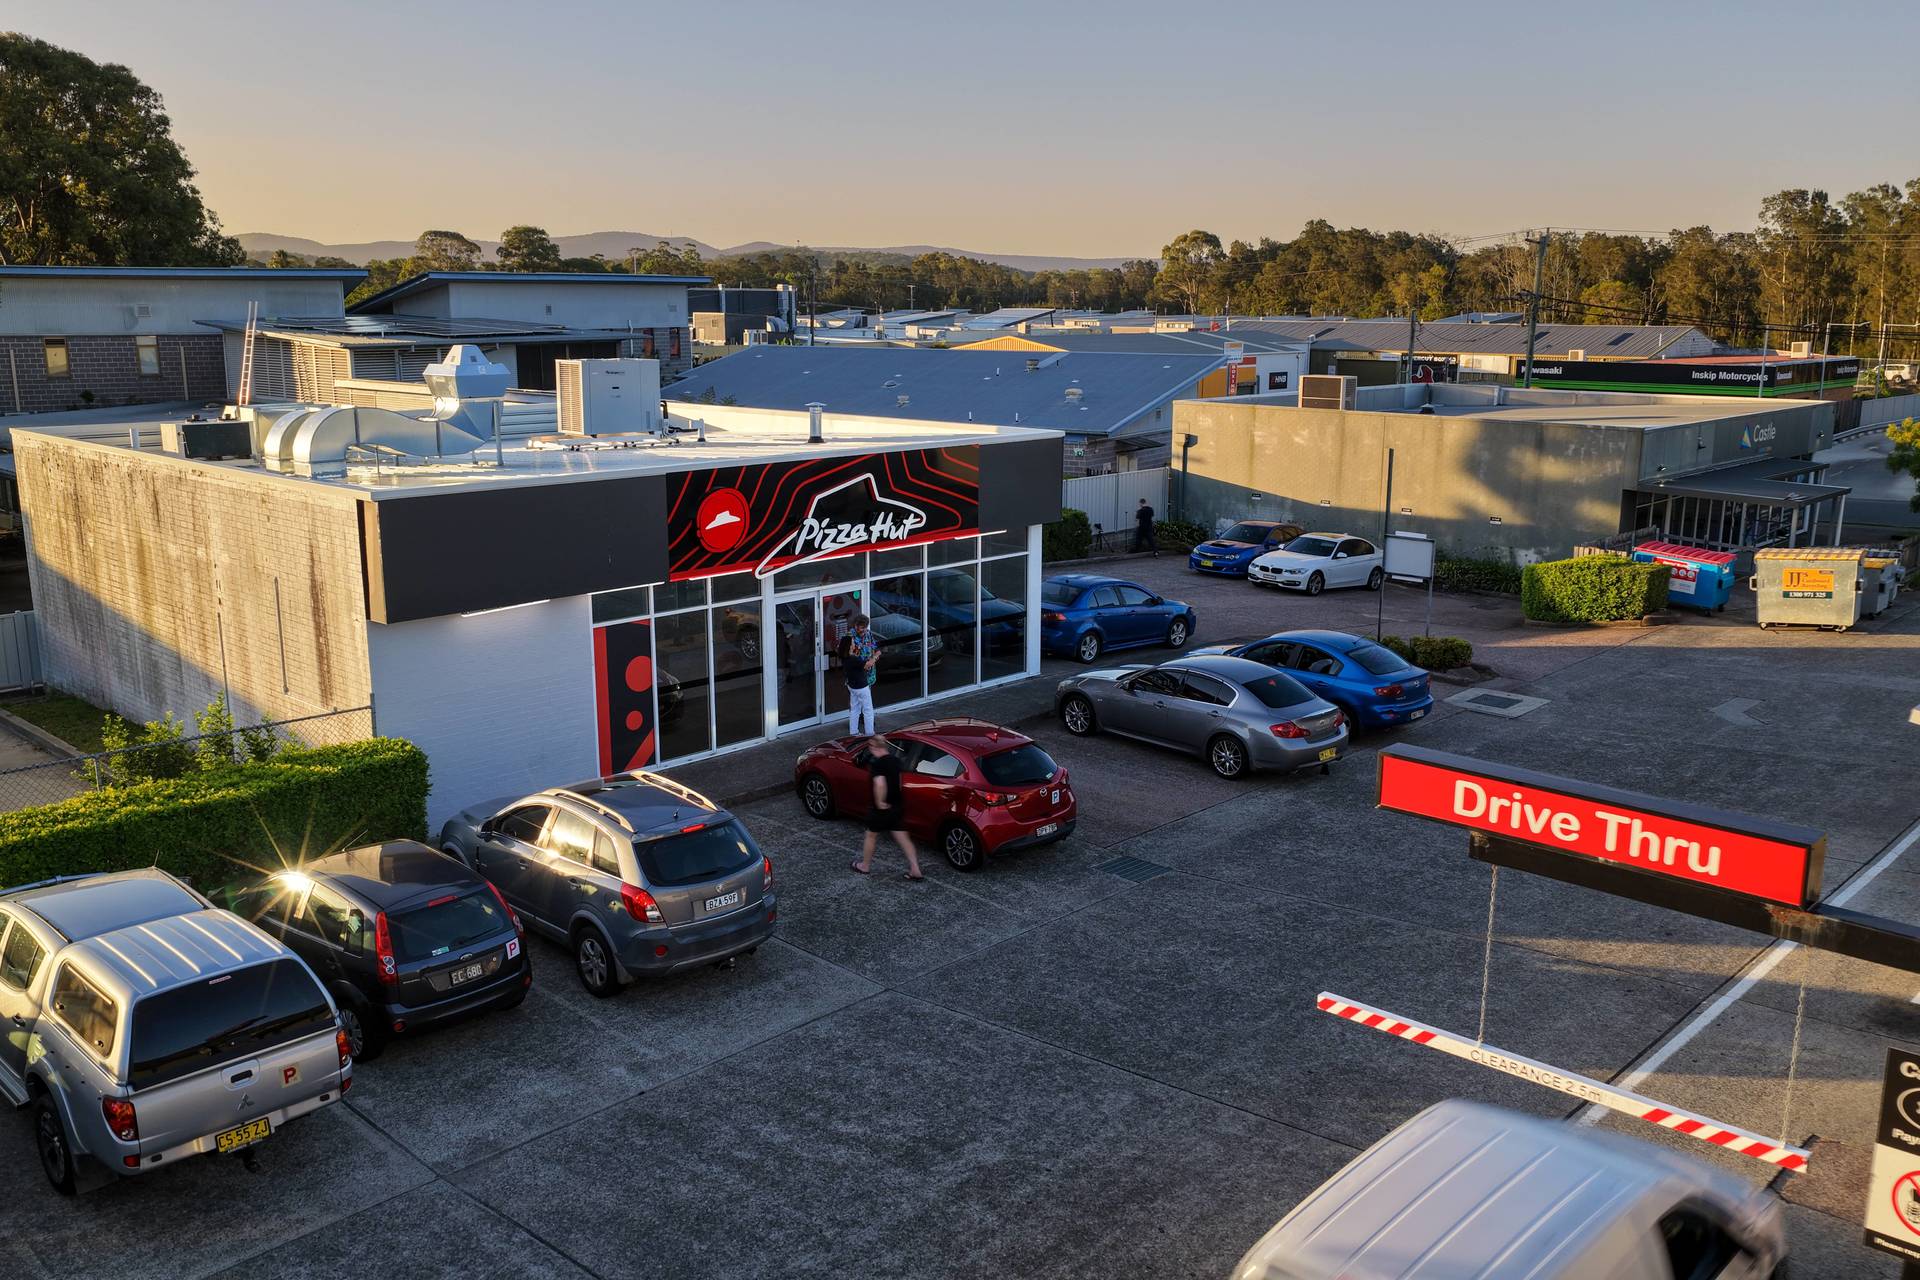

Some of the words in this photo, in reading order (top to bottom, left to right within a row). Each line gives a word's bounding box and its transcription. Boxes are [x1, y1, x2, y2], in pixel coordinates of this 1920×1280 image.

[1521, 366, 1563, 375] Kwasaki
[1691, 370, 1717, 381] Inskip
[1753, 421, 1776, 442] Castle
[794, 517, 869, 555] Pizza
[869, 511, 922, 544] Hut
[1453, 779, 1581, 842] Drive
[1594, 810, 1721, 877] Thru
[508, 941, 517, 956] P
[283, 1066, 297, 1084] P
[1470, 1049, 1561, 1089] CLEARANCE
[1891, 1127, 1920, 1146] Pay
